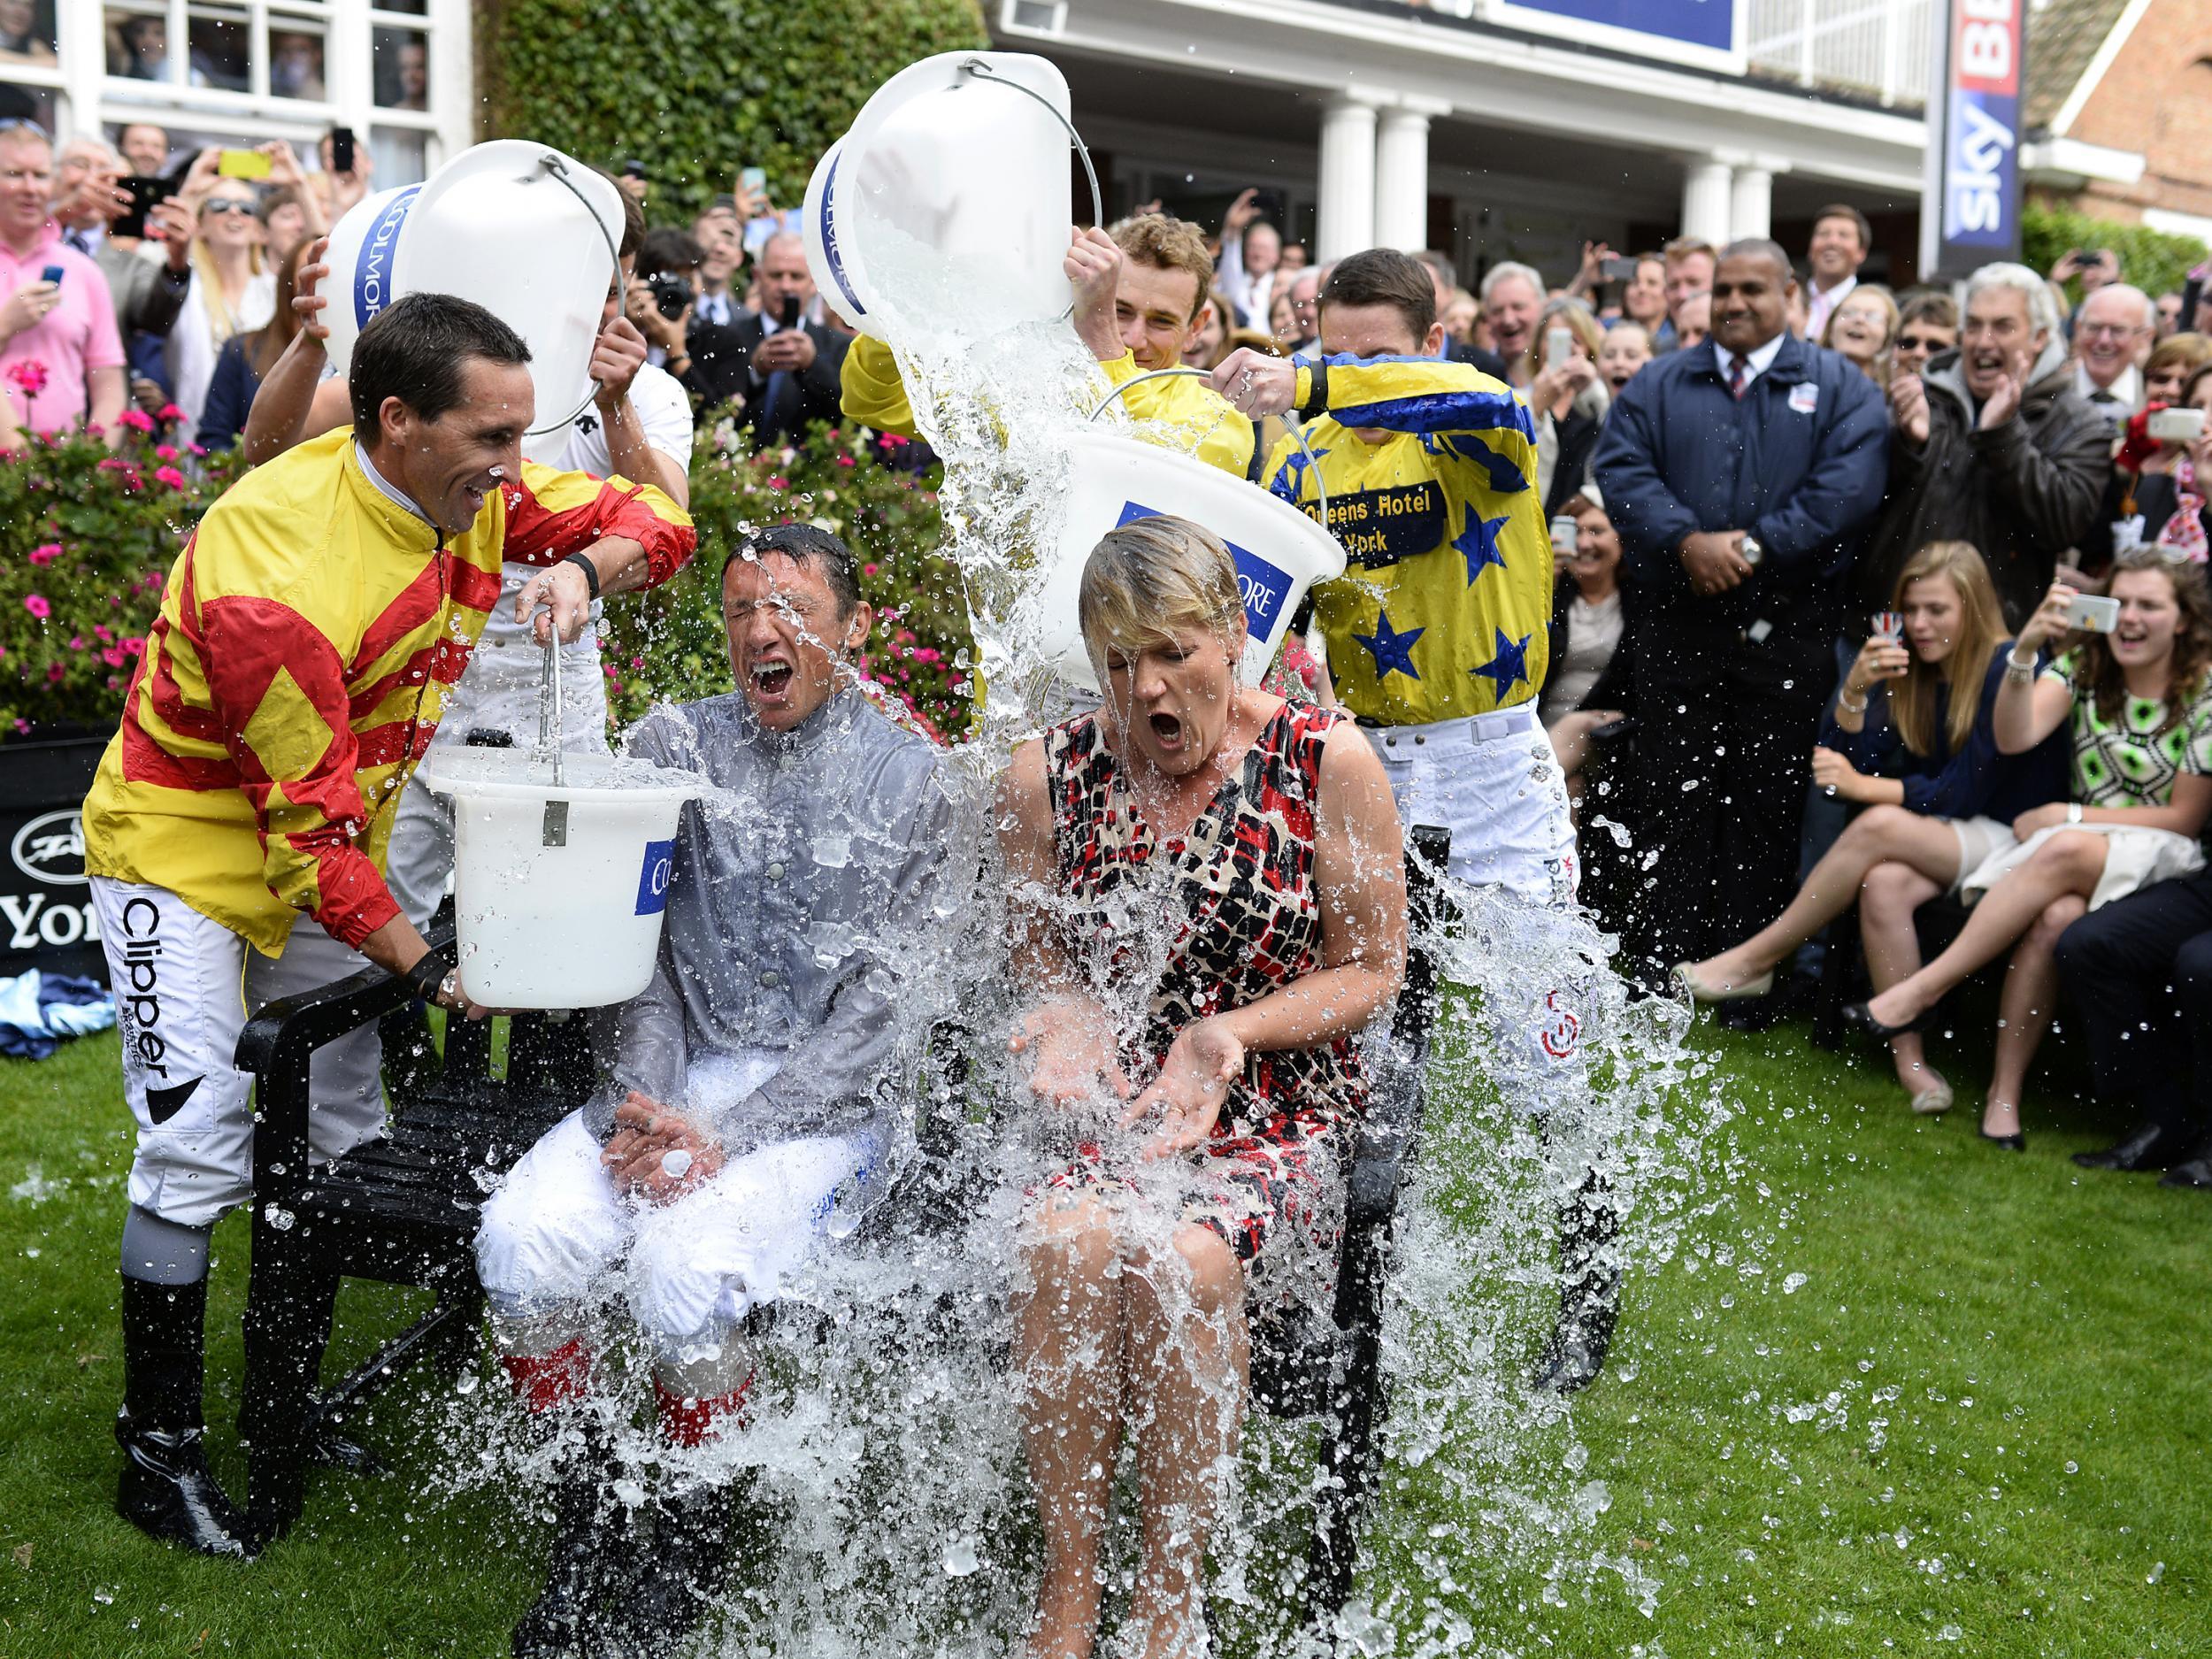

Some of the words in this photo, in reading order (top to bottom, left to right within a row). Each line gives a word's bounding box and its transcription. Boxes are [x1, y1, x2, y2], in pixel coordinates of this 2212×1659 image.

[1378, 489, 1431, 517] Hotel
[1345, 530, 1388, 556] York
[122, 897, 168, 1079] Clipper
